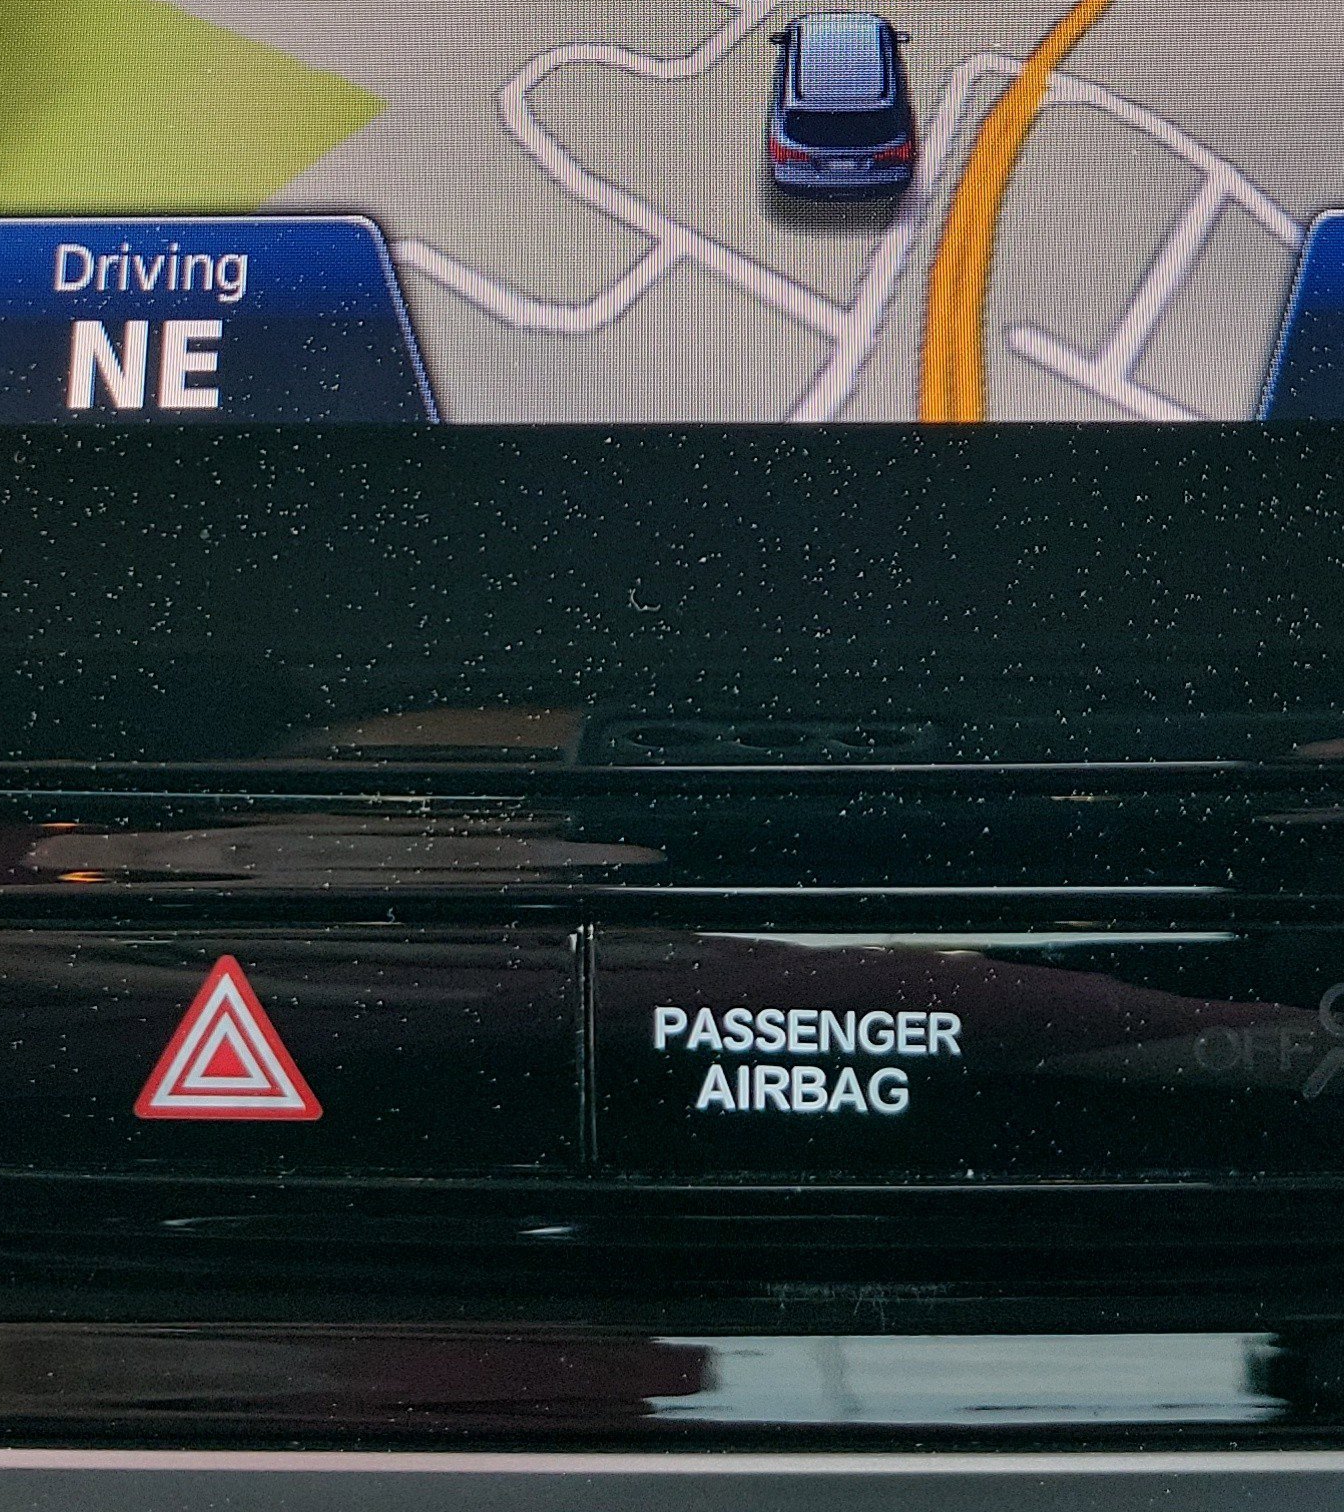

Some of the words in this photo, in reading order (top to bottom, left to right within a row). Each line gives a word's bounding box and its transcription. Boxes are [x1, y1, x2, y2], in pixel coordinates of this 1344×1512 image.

[54, 241, 250, 303] Driving
[66, 319, 224, 410] NE
[654, 1006, 963, 1056] PASSENGER
[694, 1064, 912, 1115] AIRBAG
